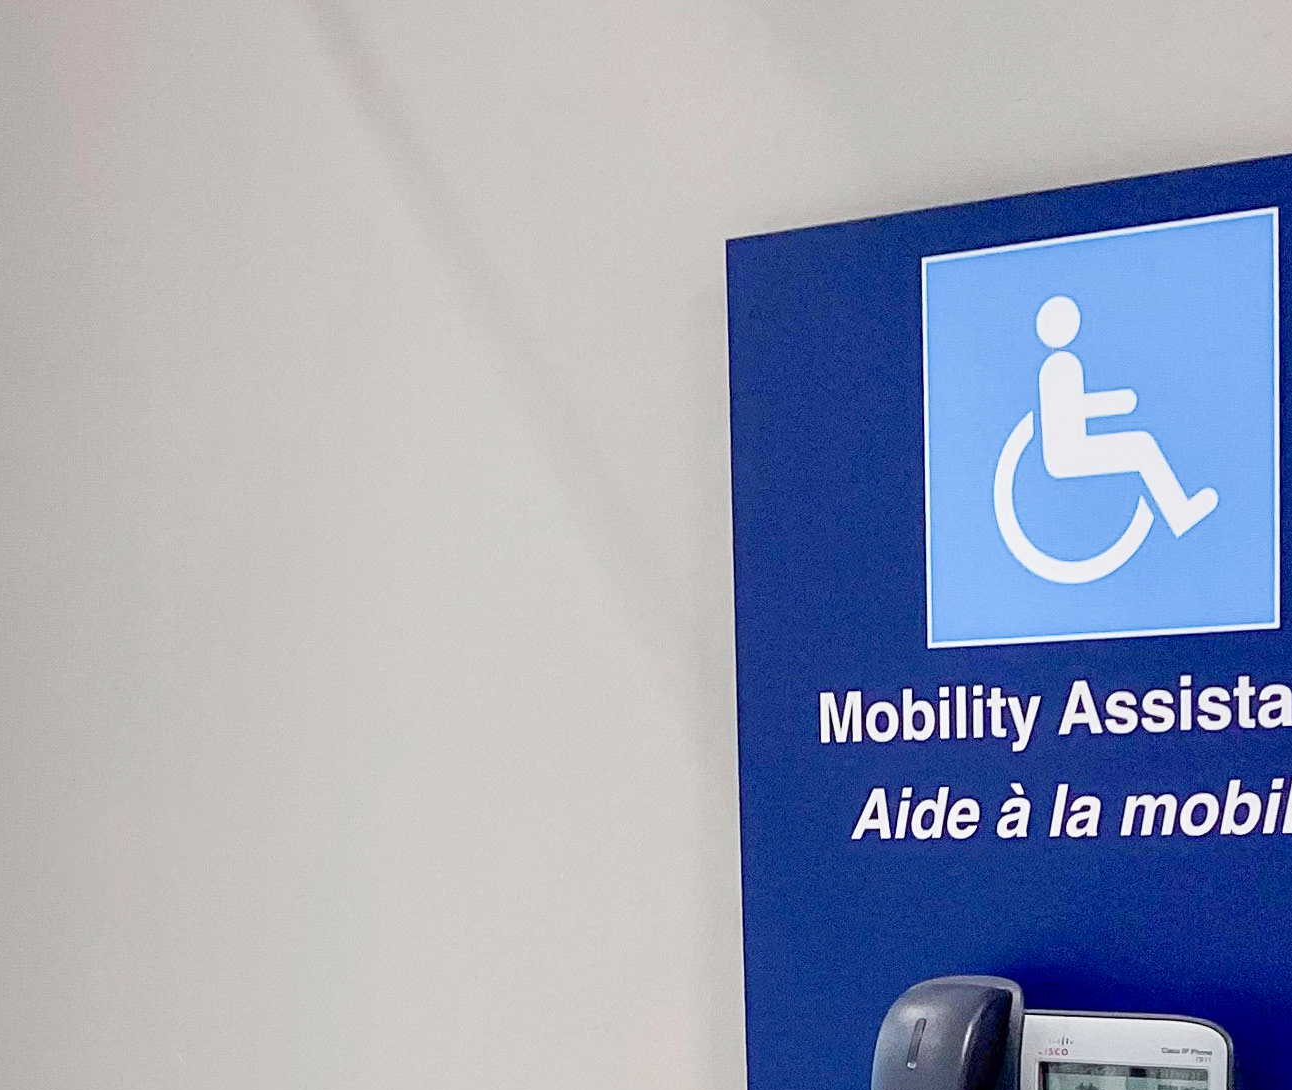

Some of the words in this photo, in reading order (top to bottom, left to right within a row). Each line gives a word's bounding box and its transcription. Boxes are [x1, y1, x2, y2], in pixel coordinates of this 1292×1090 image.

[819, 684, 1042, 752] Mobility
[851, 786, 980, 840] Aide
[996, 782, 1031, 839] à
[1049, 783, 1102, 838] la
